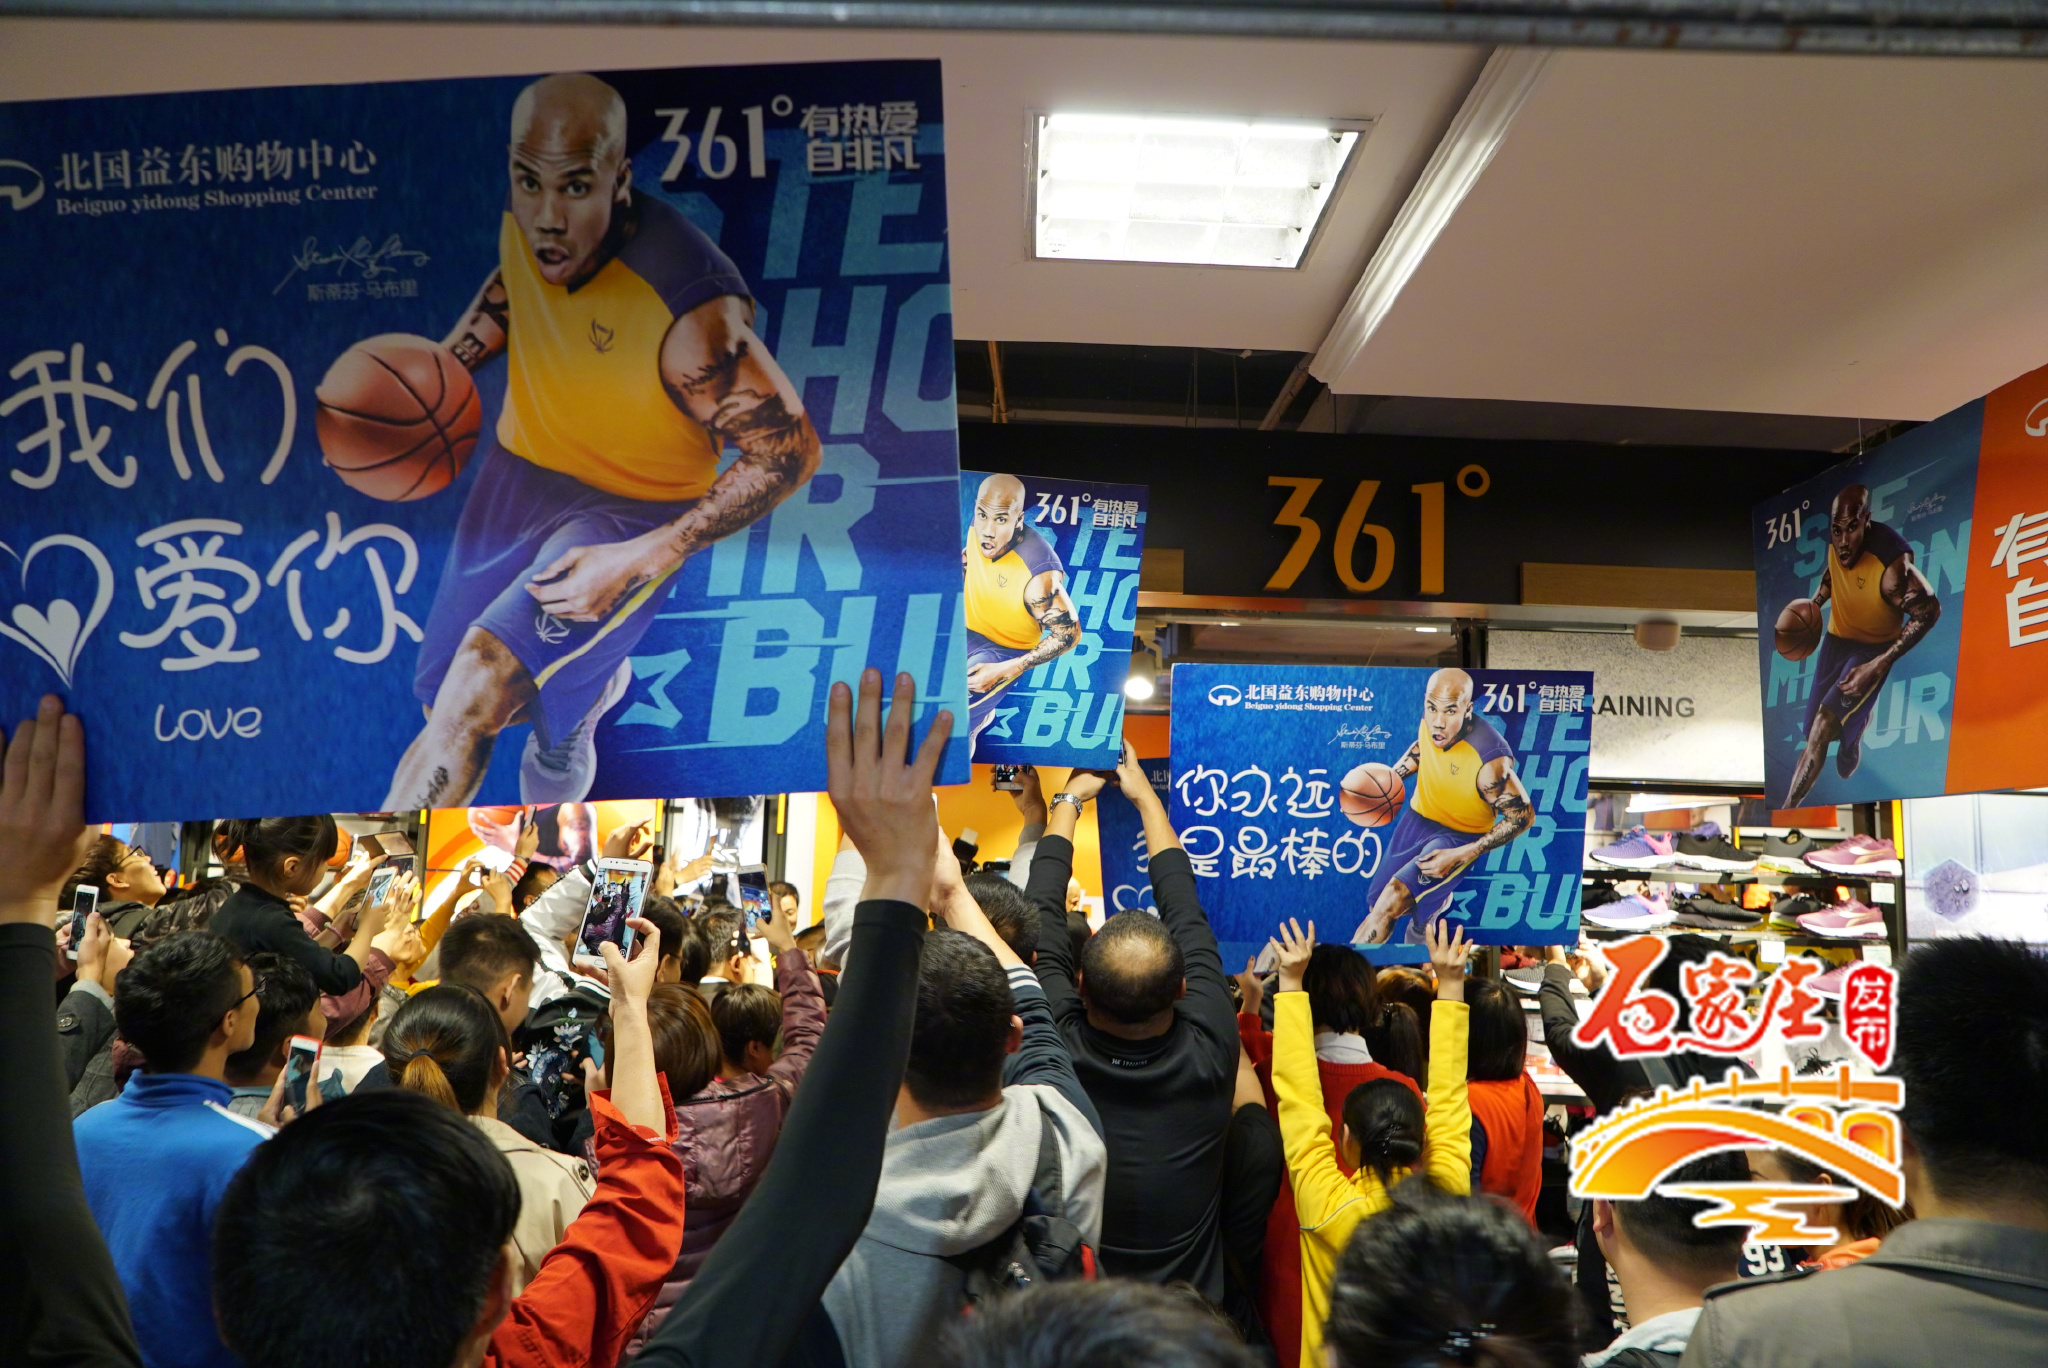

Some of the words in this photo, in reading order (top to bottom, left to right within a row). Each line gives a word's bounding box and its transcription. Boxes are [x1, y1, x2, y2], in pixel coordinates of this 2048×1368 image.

[800, 101, 919, 136] 有热爱
[654, 94, 793, 181] 361°
[806, 135, 921, 172] 自非凡
[54, 139, 378, 191] 北国益东购物中心
[56, 197, 127, 217] Beiguo
[132, 190, 200, 214] yidong
[204, 186, 301, 207] Shopping
[305, 184, 378, 202] Center
[0, 328, 297, 489] 我们
[1035, 492, 1091, 525] 361°
[1092, 498, 1139, 514] 有热爱
[1092, 512, 1139, 529] 自非凡
[1263, 463, 1491, 595] 361°
[1765, 500, 1810, 550] 361°
[119, 511, 424, 671] 爱你
[1244, 684, 1374, 702] 北国益东购物中心
[1244, 702, 1274, 711] Beiguo
[1275, 703, 1303, 712] yidong
[1304, 702, 1342, 712] Shopping
[1344, 703, 1373, 712] Center
[1482, 681, 1537, 713] 361°
[1538, 684, 1585, 699] 有热爱
[1538, 698, 1585, 713] 自非凡
[1176, 764, 1335, 819] 你永远
[1178, 826, 1382, 880] 是最棒的
[1742, 1244, 1786, 1276] 93
